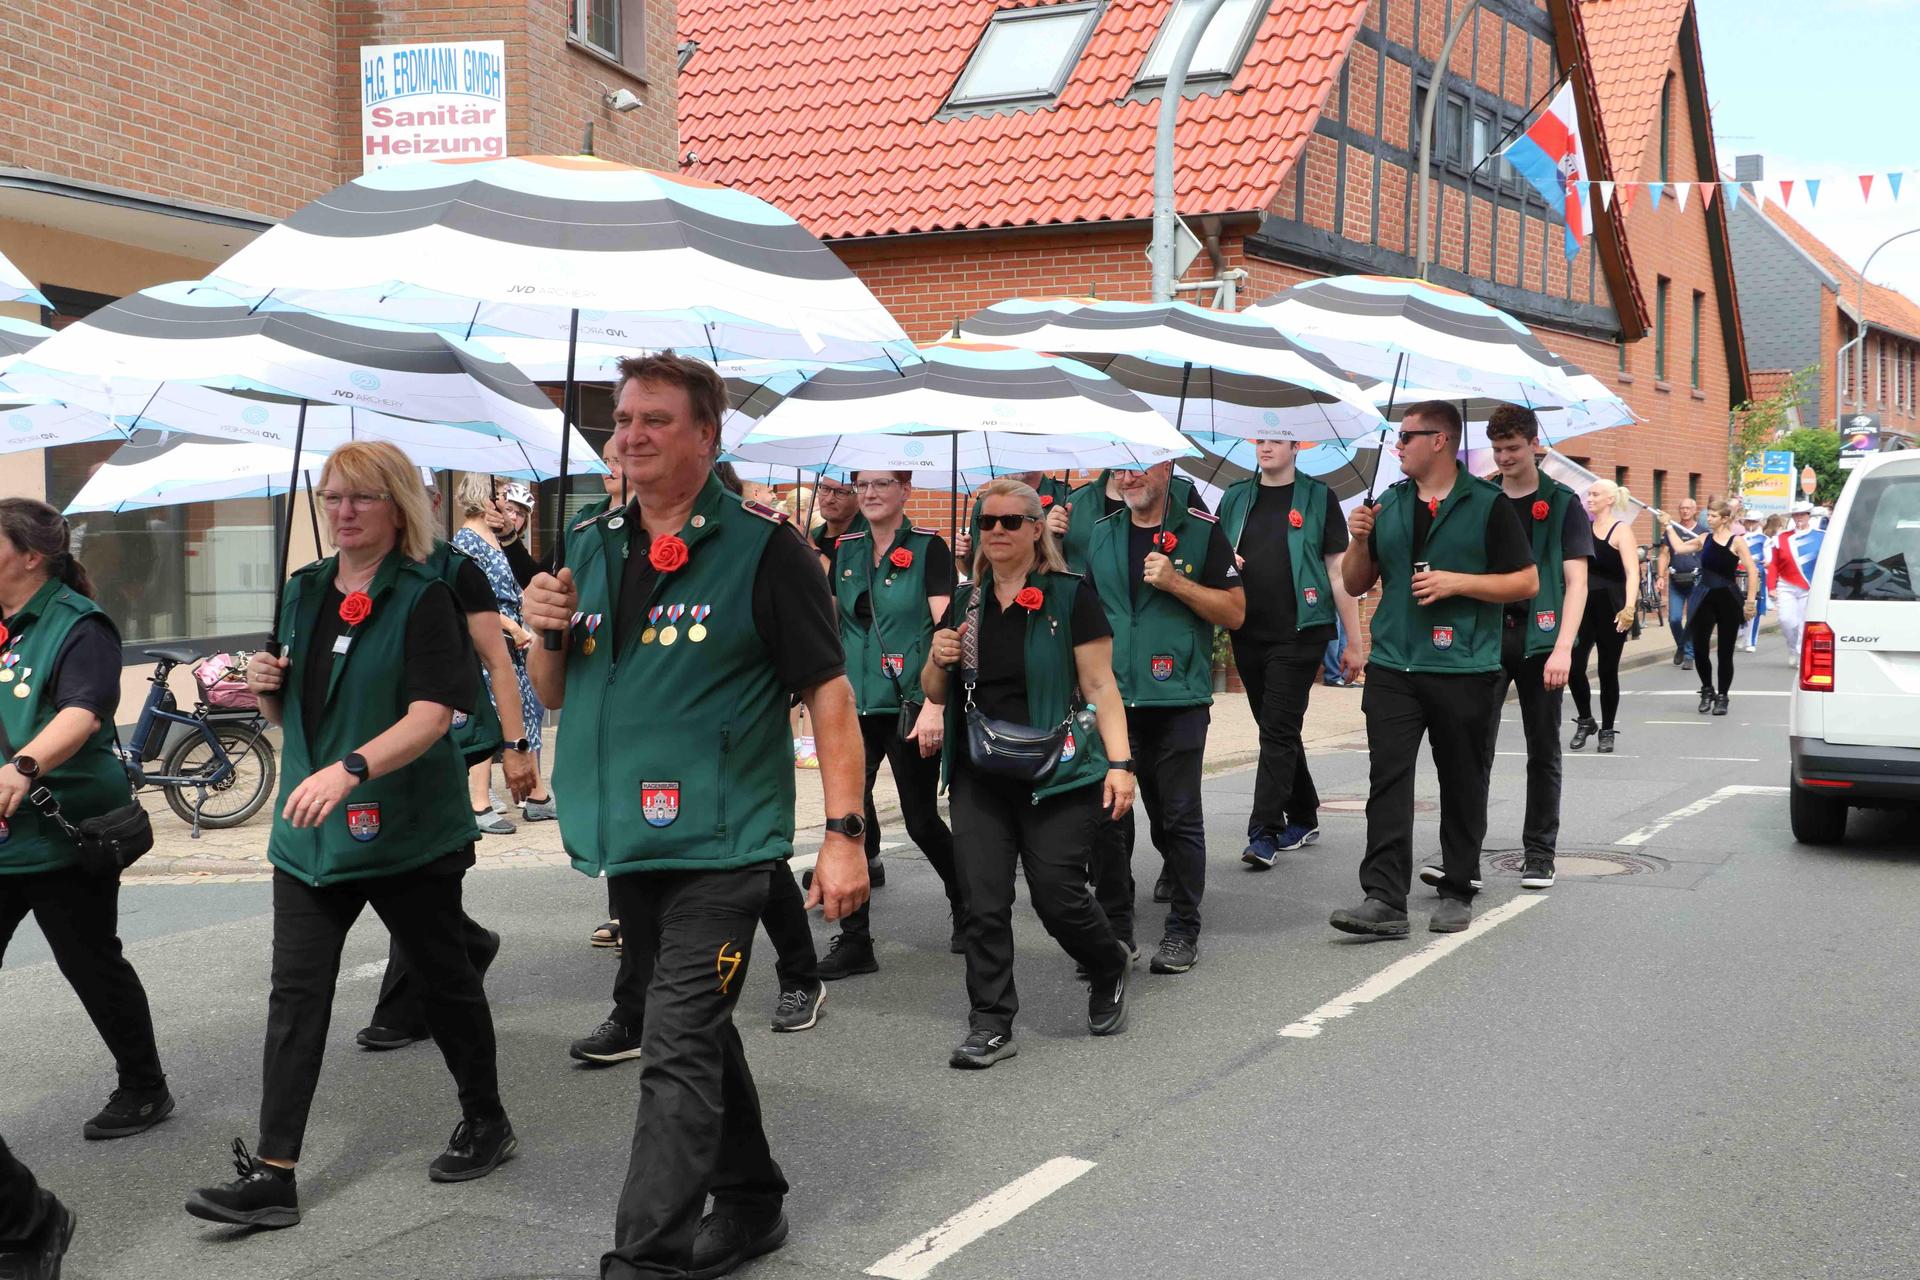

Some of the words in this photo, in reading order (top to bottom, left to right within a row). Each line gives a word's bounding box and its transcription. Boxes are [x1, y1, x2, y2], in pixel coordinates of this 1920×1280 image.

[365, 56, 388, 104] H.G.
[393, 48, 457, 95] ERDMANN
[464, 48, 501, 98] GMBH
[371, 103, 496, 128] Sanitär
[365, 133, 503, 157] Heizung
[506, 285, 536, 294] JVD
[331, 389, 354, 399] JVD
[1840, 635, 1880, 643] CADDY
